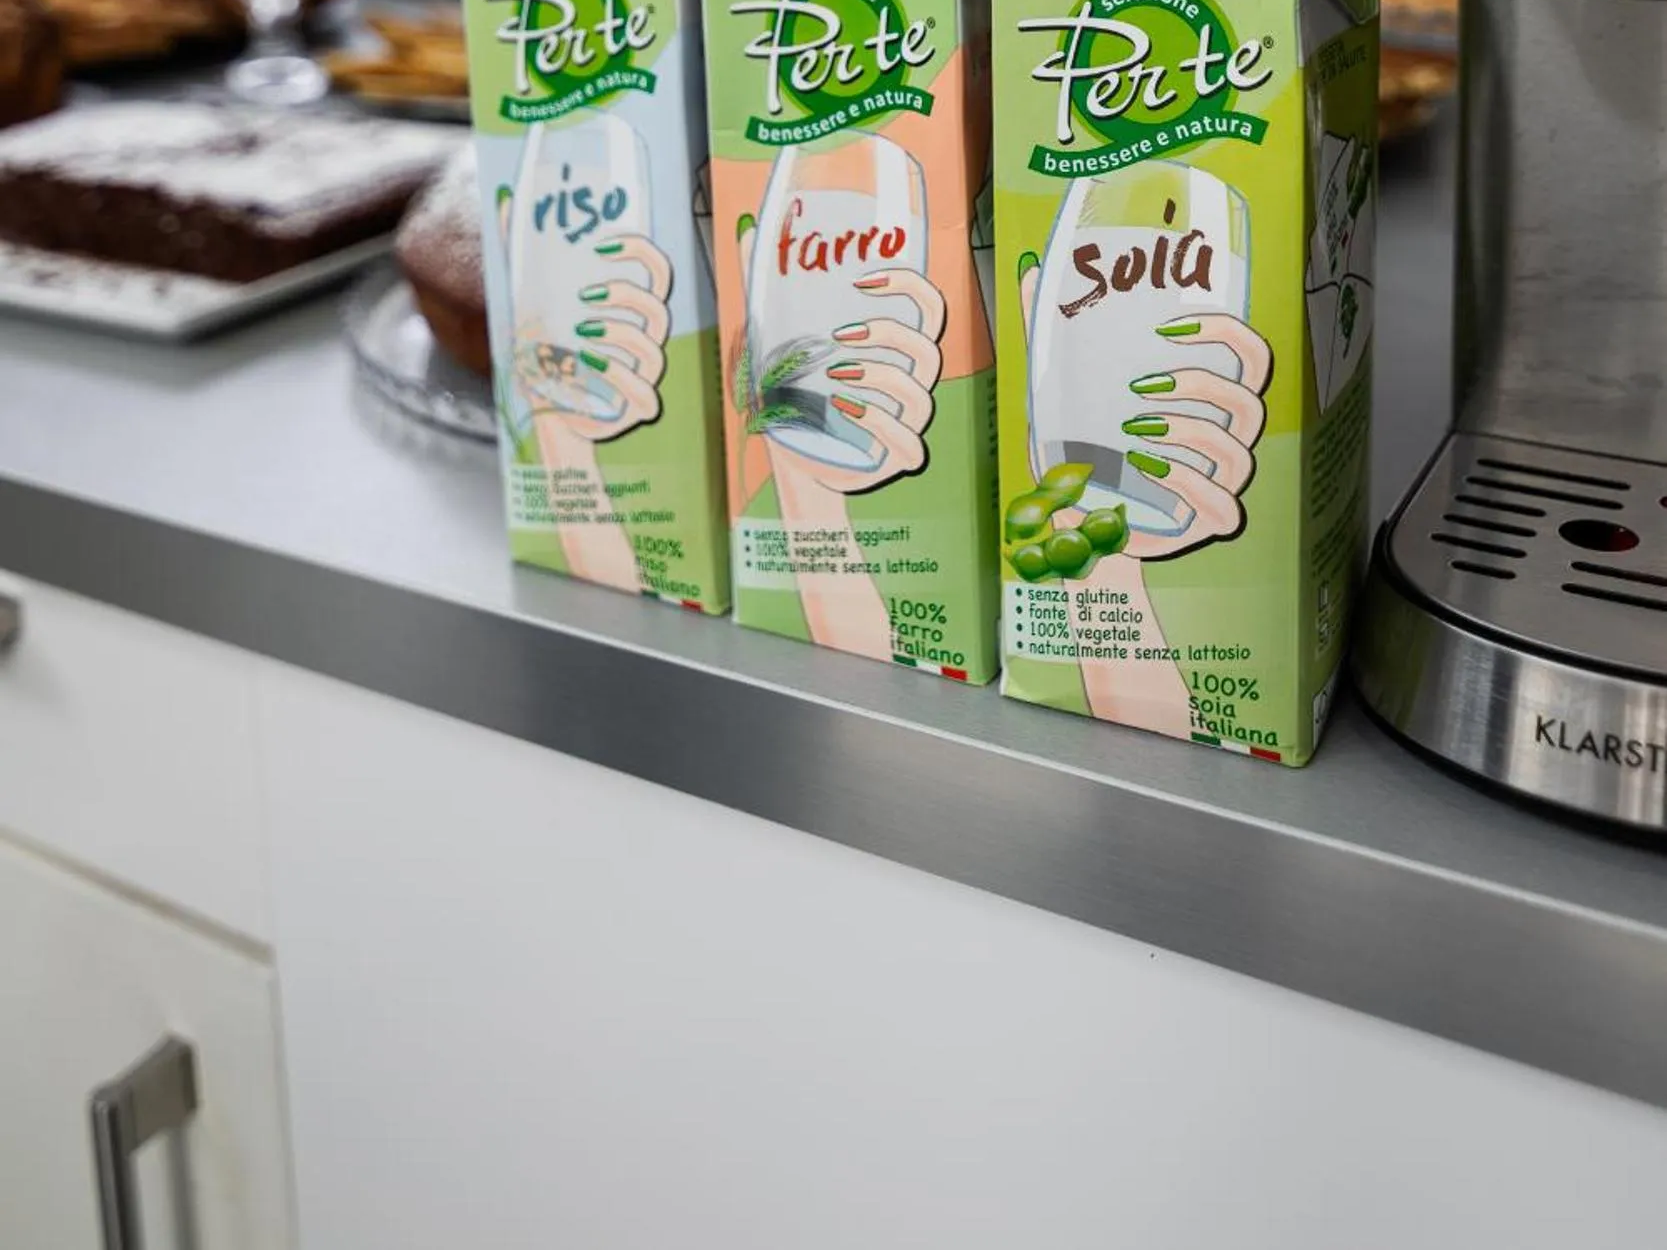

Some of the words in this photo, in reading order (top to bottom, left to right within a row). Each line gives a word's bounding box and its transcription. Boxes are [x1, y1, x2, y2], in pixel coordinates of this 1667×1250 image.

[509, 88, 583, 119] benessere
[585, 81, 594, 96] e
[596, 72, 648, 92] natura
[757, 111, 847, 143] benessere
[849, 102, 860, 117] e
[863, 88, 923, 112] natura
[1044, 136, 1153, 173] benessere
[1156, 129, 1169, 146] e
[1175, 114, 1253, 139] natura
[533, 162, 627, 243] riso
[778, 197, 906, 276] farro
[1059, 198, 1214, 319] soia
[794, 528, 848, 541] zuccheri
[854, 526, 910, 546] aggiunti
[843, 562, 881, 573] senza
[886, 558, 939, 573] lattosio
[639, 570, 701, 597] italiano
[1028, 588, 1069, 602] senza
[1076, 587, 1129, 607] glutine
[889, 597, 947, 624] 100%
[1030, 604, 1066, 620] fonte
[1078, 606, 1092, 622] di
[1100, 606, 1143, 623] calcio
[889, 615, 943, 643] farro
[1030, 623, 1069, 639] 100%
[1076, 627, 1141, 645] vegetale
[890, 633, 965, 666] italiano
[1029, 641, 1128, 659] naturalmente
[1134, 647, 1181, 661] senza
[1188, 643, 1251, 661] lattosio
[1191, 671, 1260, 701] 100%
[1189, 695, 1236, 719] soia
[1190, 713, 1279, 747] italiana
